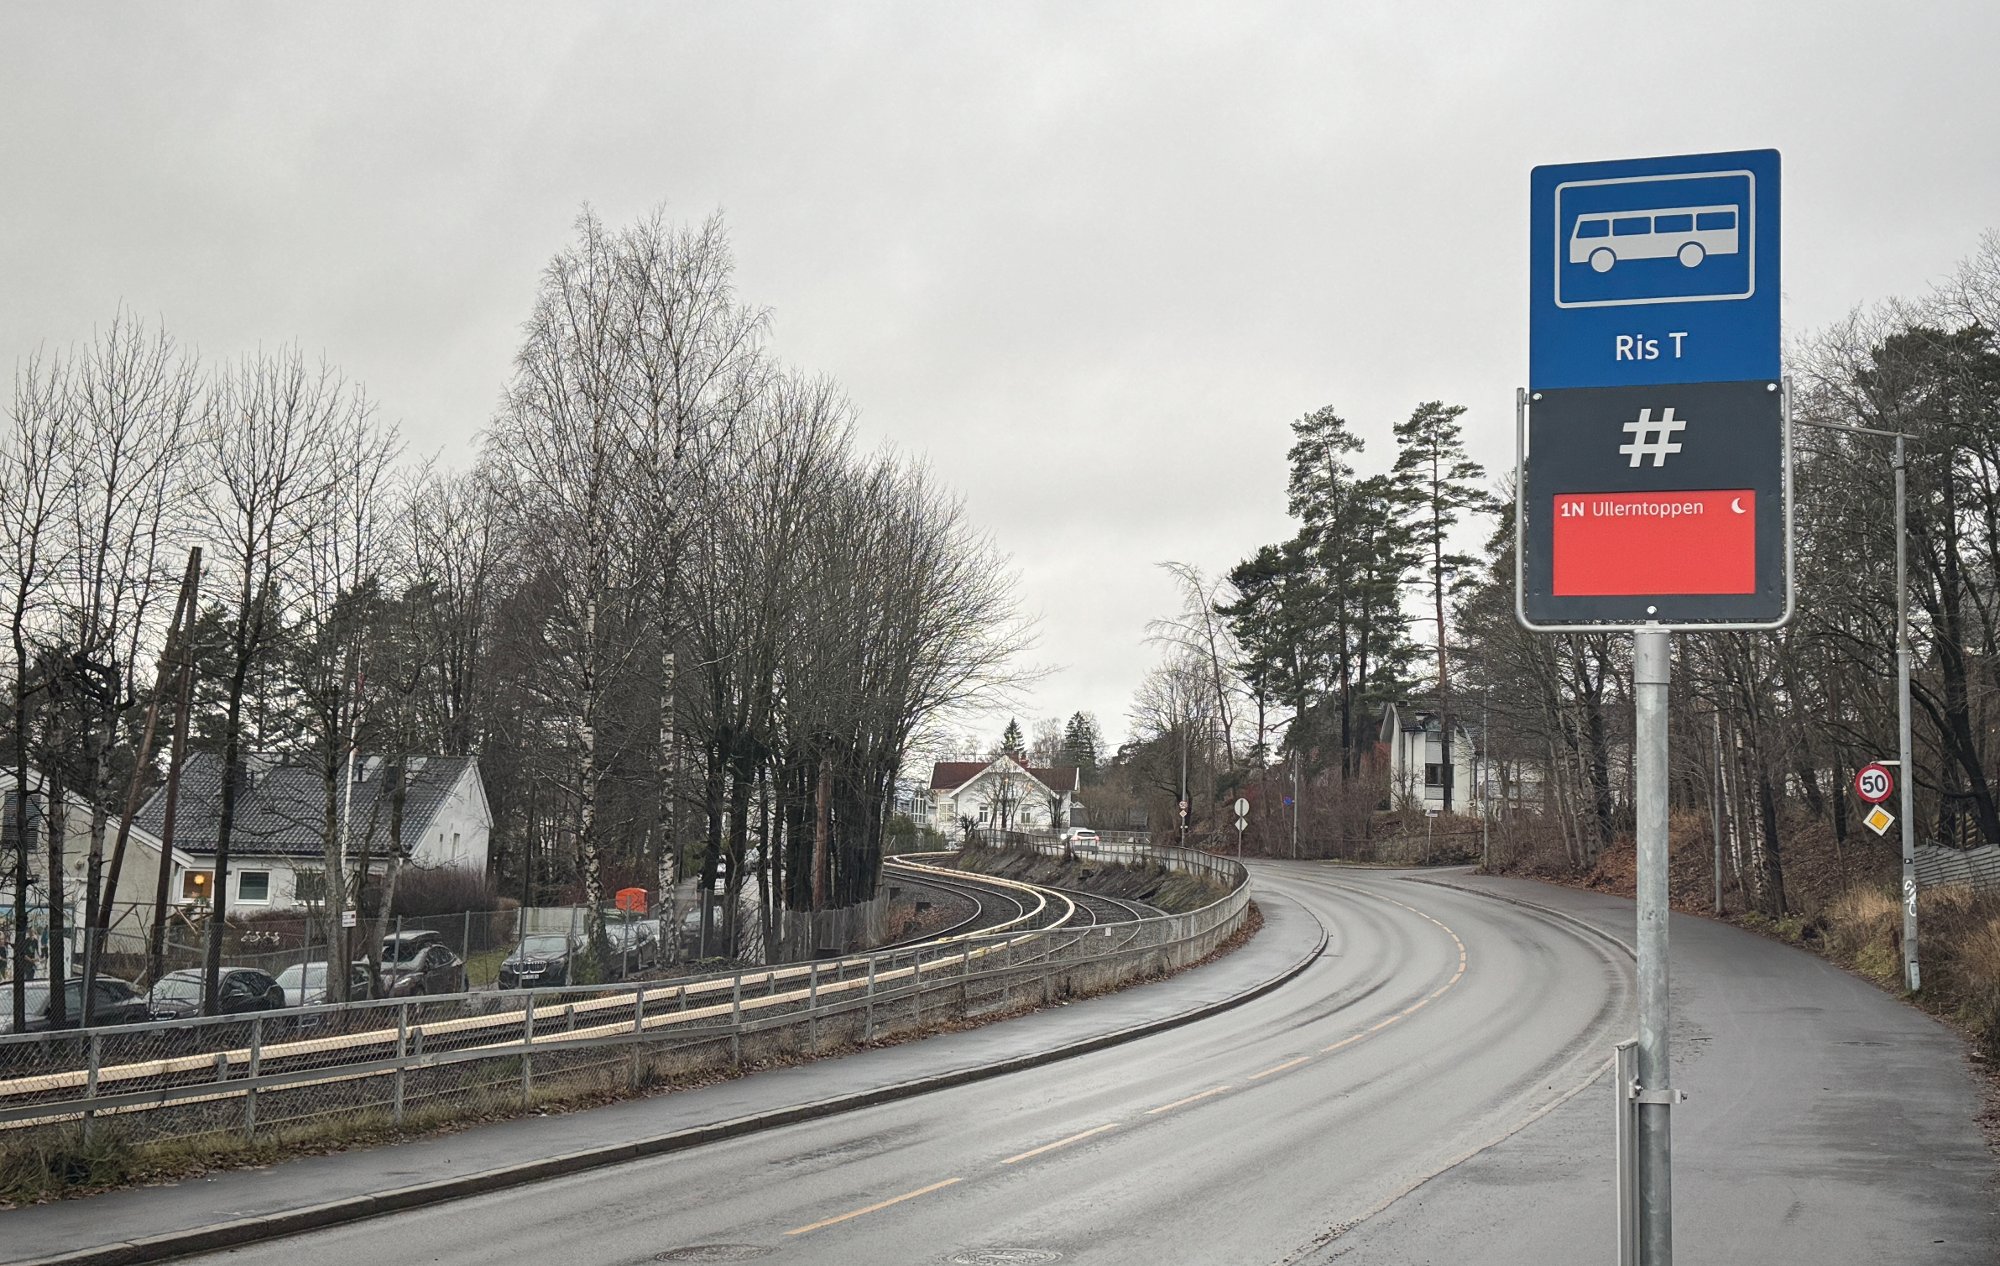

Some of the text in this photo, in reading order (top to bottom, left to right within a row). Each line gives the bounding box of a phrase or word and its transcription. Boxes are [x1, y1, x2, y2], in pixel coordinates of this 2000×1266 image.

[1616, 332, 1689, 361] Ris T
[1560, 501, 1704, 518] 1N Ullerntoppen
[1862, 774, 1886, 794] 50
